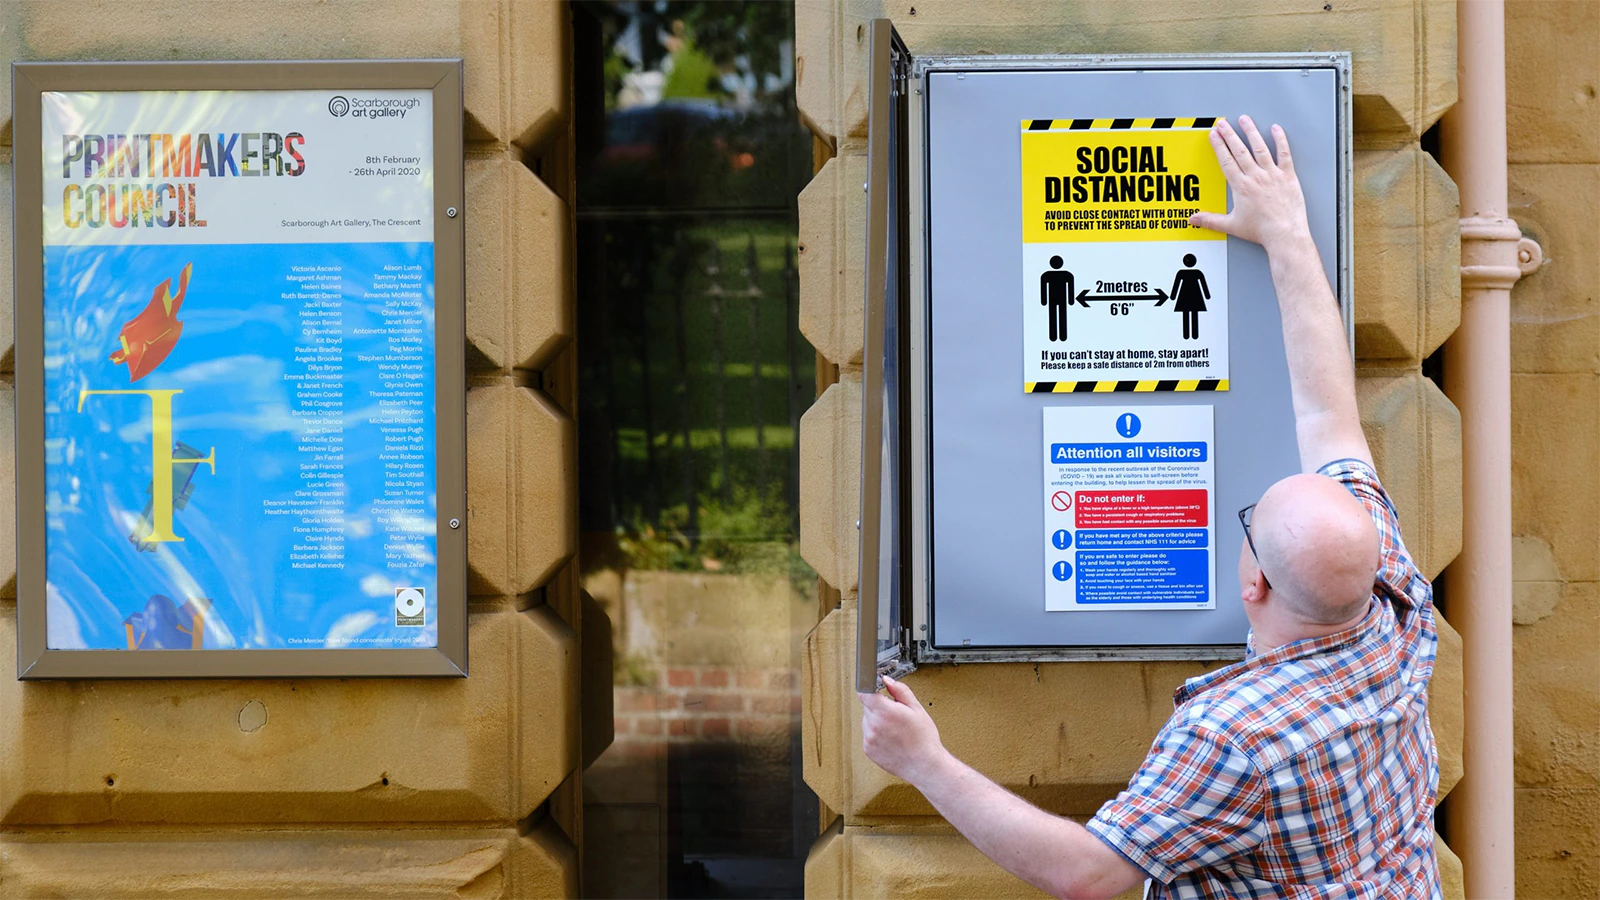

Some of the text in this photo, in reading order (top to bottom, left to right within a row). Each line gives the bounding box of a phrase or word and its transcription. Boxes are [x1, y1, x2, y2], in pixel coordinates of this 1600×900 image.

[352, 98, 420, 109] Scarborough
[352, 108, 406, 119] art gallery
[62, 132, 306, 178] PRINTMAKERS
[383, 155, 420, 164] February
[1076, 146, 1168, 174] SOCIAL
[376, 168, 395, 176] April
[1045, 174, 1199, 203] DISTANCING
[62, 182, 208, 228] COUNCIL
[1045, 210, 1070, 219] AVOID
[1073, 210, 1098, 219] CLOSE
[1101, 209, 1139, 219] CONTACT
[1142, 209, 1164, 218] WITH
[1044, 219, 1200, 230] TO PREVENT THE SPREAD OF COVID-
[1096, 280, 1147, 292] 2metres
[1042, 350, 1047, 359] If
[1050, 351, 1066, 360] you
[1094, 350, 1114, 360] stay
[1116, 350, 1125, 358] at
[1128, 349, 1156, 359] home,
[1158, 349, 1178, 359] stay
[1180, 349, 1208, 358] apart!
[1067, 361, 1085, 369] keep
[1057, 446, 1200, 458] Attention all visitors
[1079, 495, 1091, 503] Do
